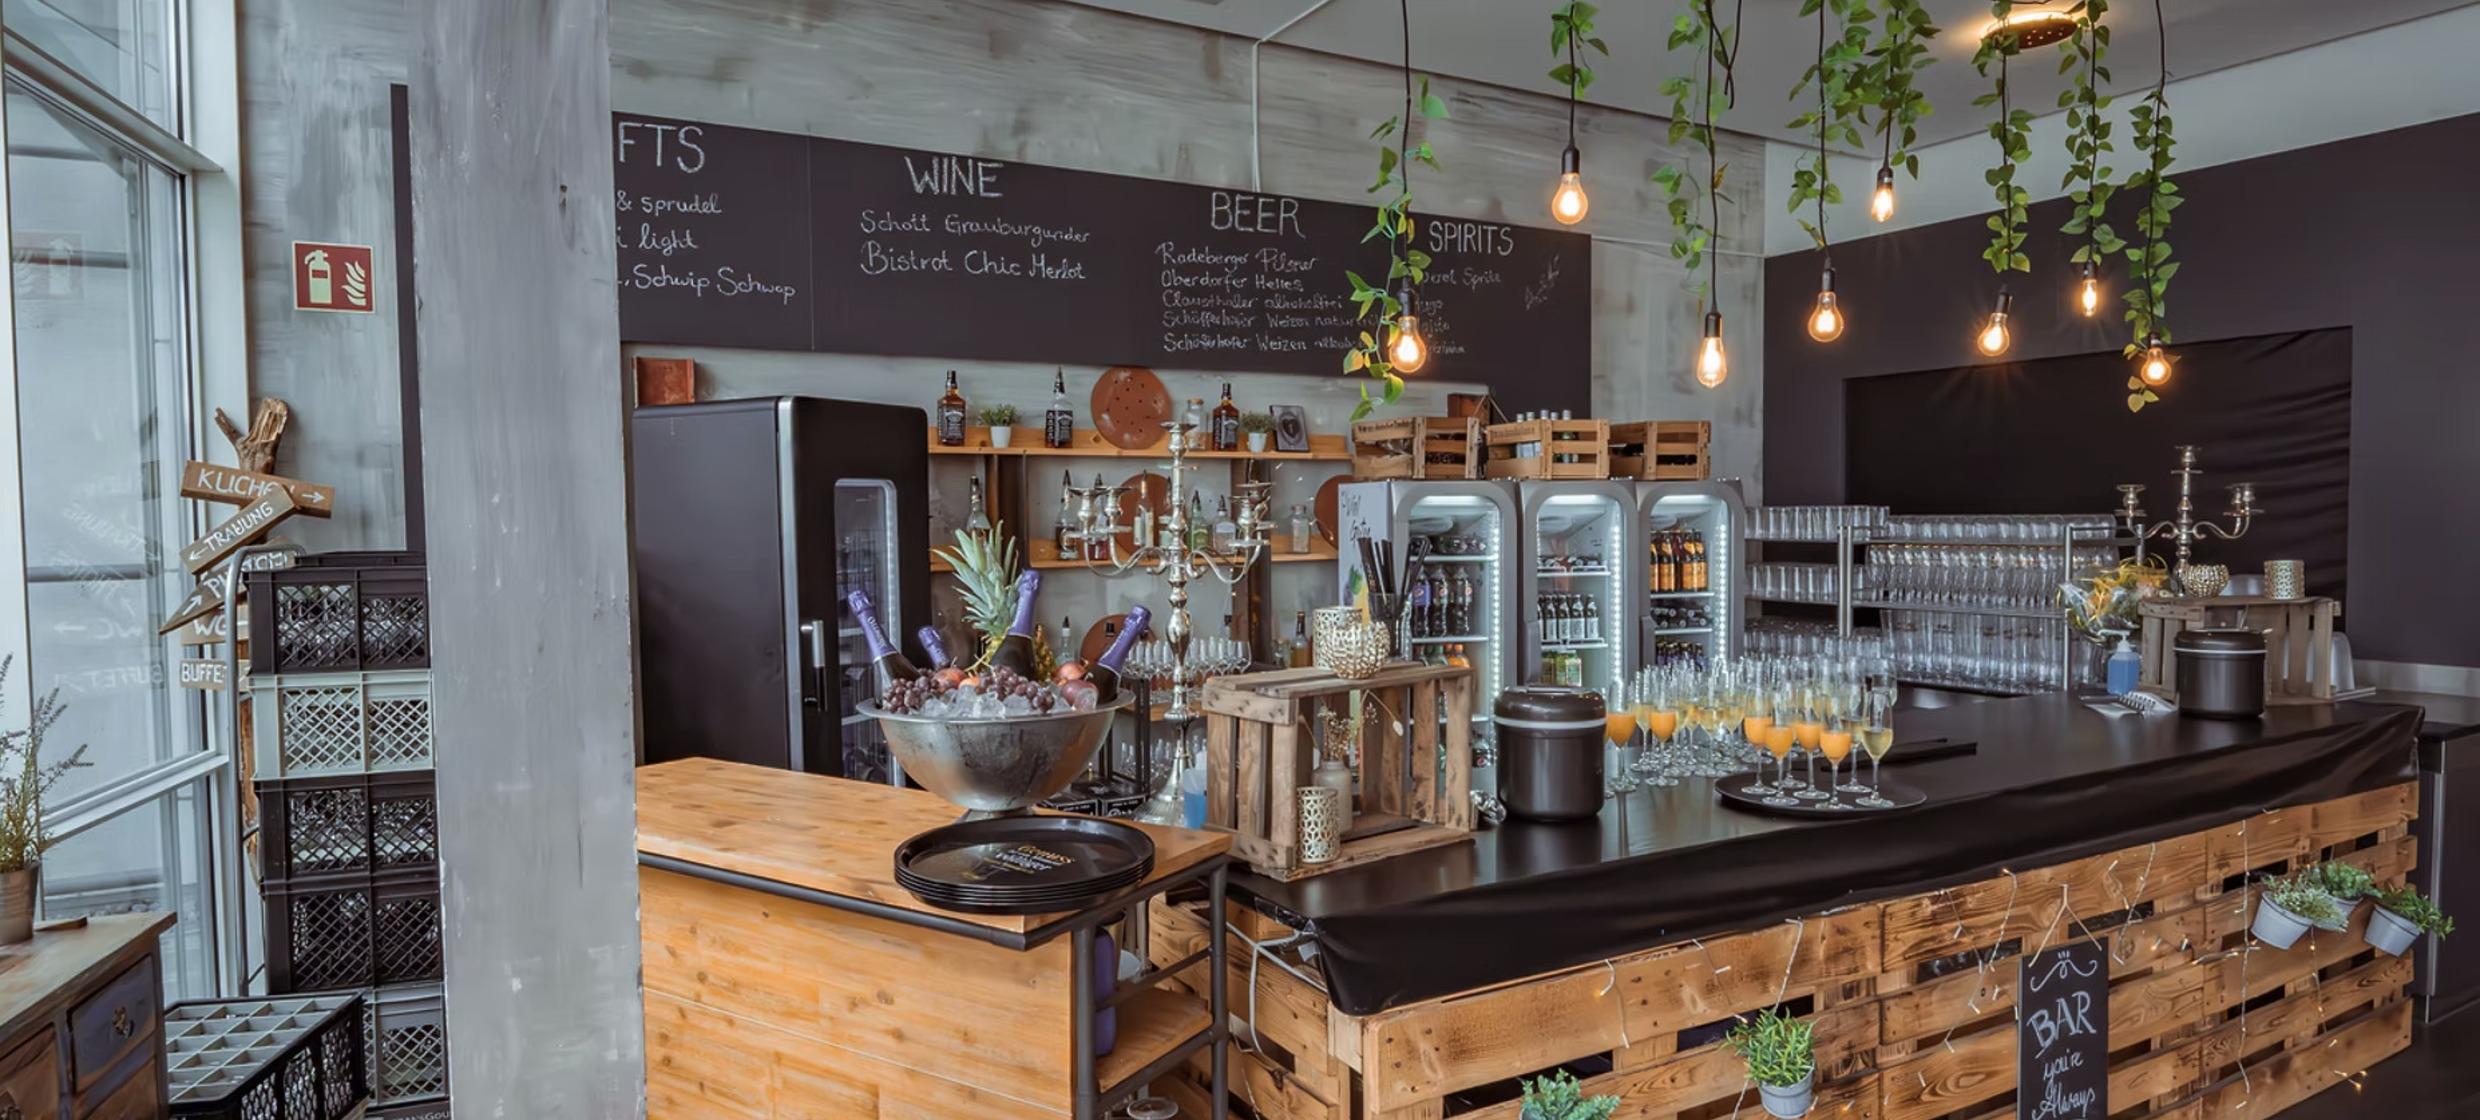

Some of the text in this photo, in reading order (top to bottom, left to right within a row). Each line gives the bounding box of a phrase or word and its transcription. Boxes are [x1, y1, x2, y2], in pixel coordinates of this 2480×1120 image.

[618, 121, 705, 174] FTS
[904, 156, 1004, 198] WINE
[860, 209, 1091, 249] Schott Grauburgunder
[1211, 191, 1307, 240] BEER
[638, 222, 699, 257] light
[1428, 221, 1515, 257] SPIRITS
[860, 240, 1087, 280] Bistrot Chic Merlot
[633, 264, 711, 298] Schwip
[1255, 333, 1308, 351] Weizen
[198, 468, 295, 497] KUCHE
[203, 501, 274, 551] TRAUUNG
[180, 662, 227, 684] BUFFE
[2026, 990, 2098, 1059] BAR
